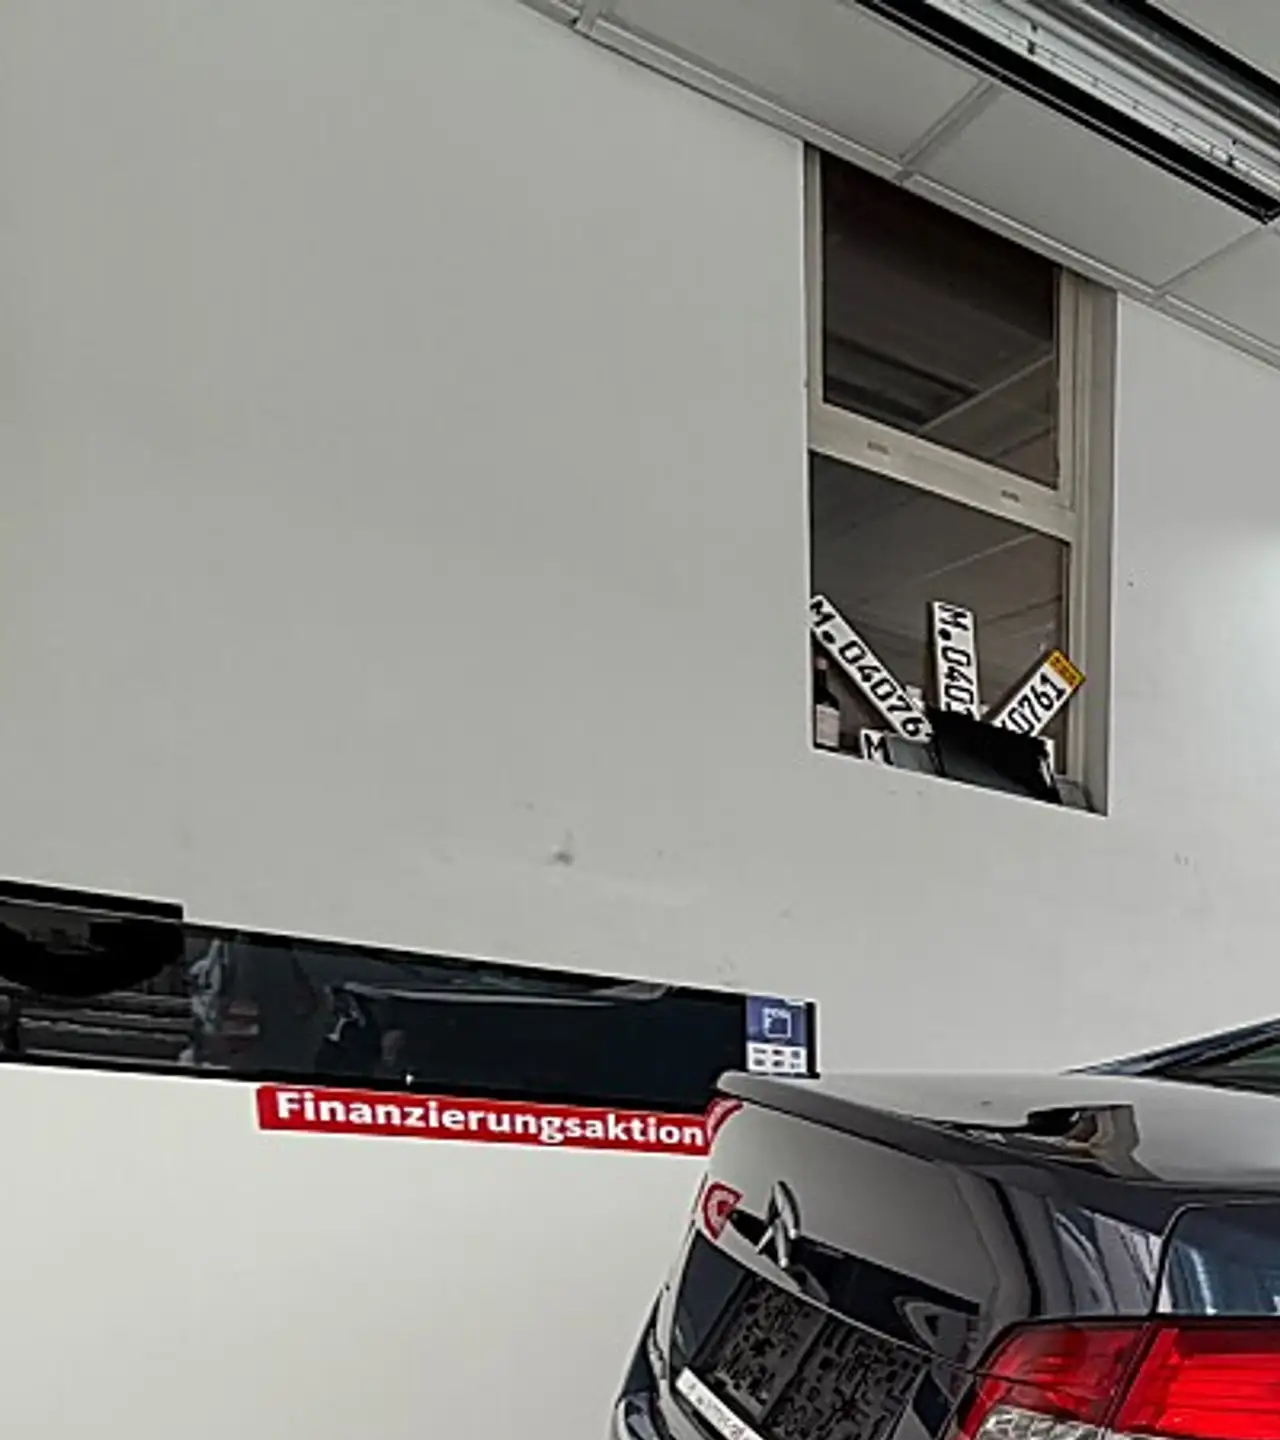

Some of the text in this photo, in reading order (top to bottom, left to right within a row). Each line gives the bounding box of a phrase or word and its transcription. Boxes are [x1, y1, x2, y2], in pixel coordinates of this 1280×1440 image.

[810, 599, 934, 738] M 04076
[938, 603, 974, 713] M 040
[1001, 672, 1066, 735] 0761
[863, 732, 894, 766] M
[276, 1090, 705, 1147] Finanzierungsaktion
